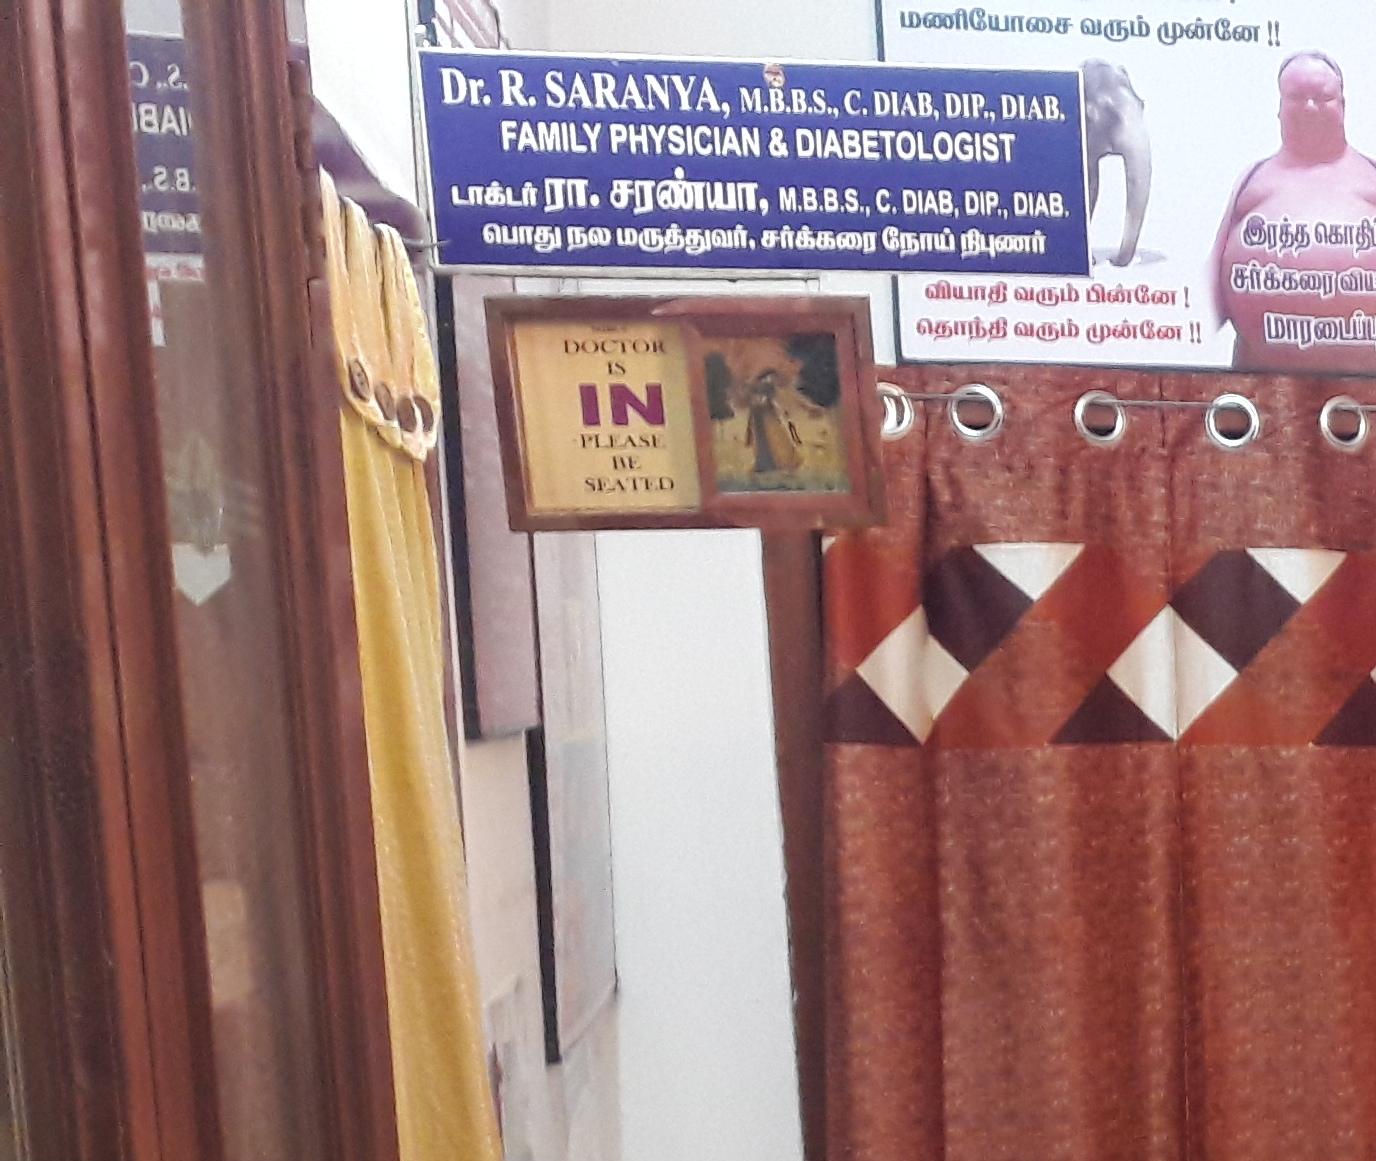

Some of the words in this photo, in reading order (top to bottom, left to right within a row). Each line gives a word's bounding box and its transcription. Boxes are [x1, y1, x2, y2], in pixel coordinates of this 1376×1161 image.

[900, 7, 1073, 35] மணியோசை
[1080, 15, 1151, 42] வரும்
[1156, 16, 1260, 46] முன்னே
[440, 67, 491, 106] Dr.
[499, 69, 536, 107] R.
[545, 70, 731, 119] SARANYA,
[740, 87, 840, 118] M.B.B.S.,
[844, 89, 868, 116] C.
[874, 91, 940, 121] DIAB,
[944, 92, 996, 123] DIP.,
[1001, 95, 1066, 122] DIAB.
[501, 120, 601, 154] FAMILY
[609, 123, 761, 158] PHYSICIAN
[769, 127, 789, 158] &
[795, 128, 1016, 162] DIABETOLOGIST
[451, 181, 538, 206] டாக்டர்
[544, 177, 600, 213] ரா.
[610, 166, 769, 216] சரண்யா,
[778, 186, 870, 217] M.B.B.S.,
[876, 189, 897, 214] C.
[902, 189, 959, 218] DIAB,
[964, 190, 1008, 219] DIP.,
[1013, 192, 1070, 218] DIAB.
[482, 224, 562, 253] பொது
[567, 226, 612, 252] நல
[761, 224, 877, 253] சர்க்கரை
[881, 225, 955, 257] நோய்
[960, 229, 1046, 260] நிபுணர்
[1242, 216, 1309, 254] இரத்த
[924, 280, 1008, 304] வியாதி
[1014, 283, 1079, 306] வரும்
[1085, 284, 1178, 307] பின்னே
[1232, 264, 1336, 297] சர்க்கரை
[916, 317, 1008, 341] தொந்தி
[1014, 319, 1079, 342] வரும்
[1085, 320, 1183, 343] முன்னே
[564, 340, 665, 354] DOCTOR
[607, 361, 626, 374] IS
[578, 383, 665, 427] IN
[581, 433, 664, 449] PLEASE
[612, 456, 641, 471] BE
[585, 477, 674, 492] SEATED
